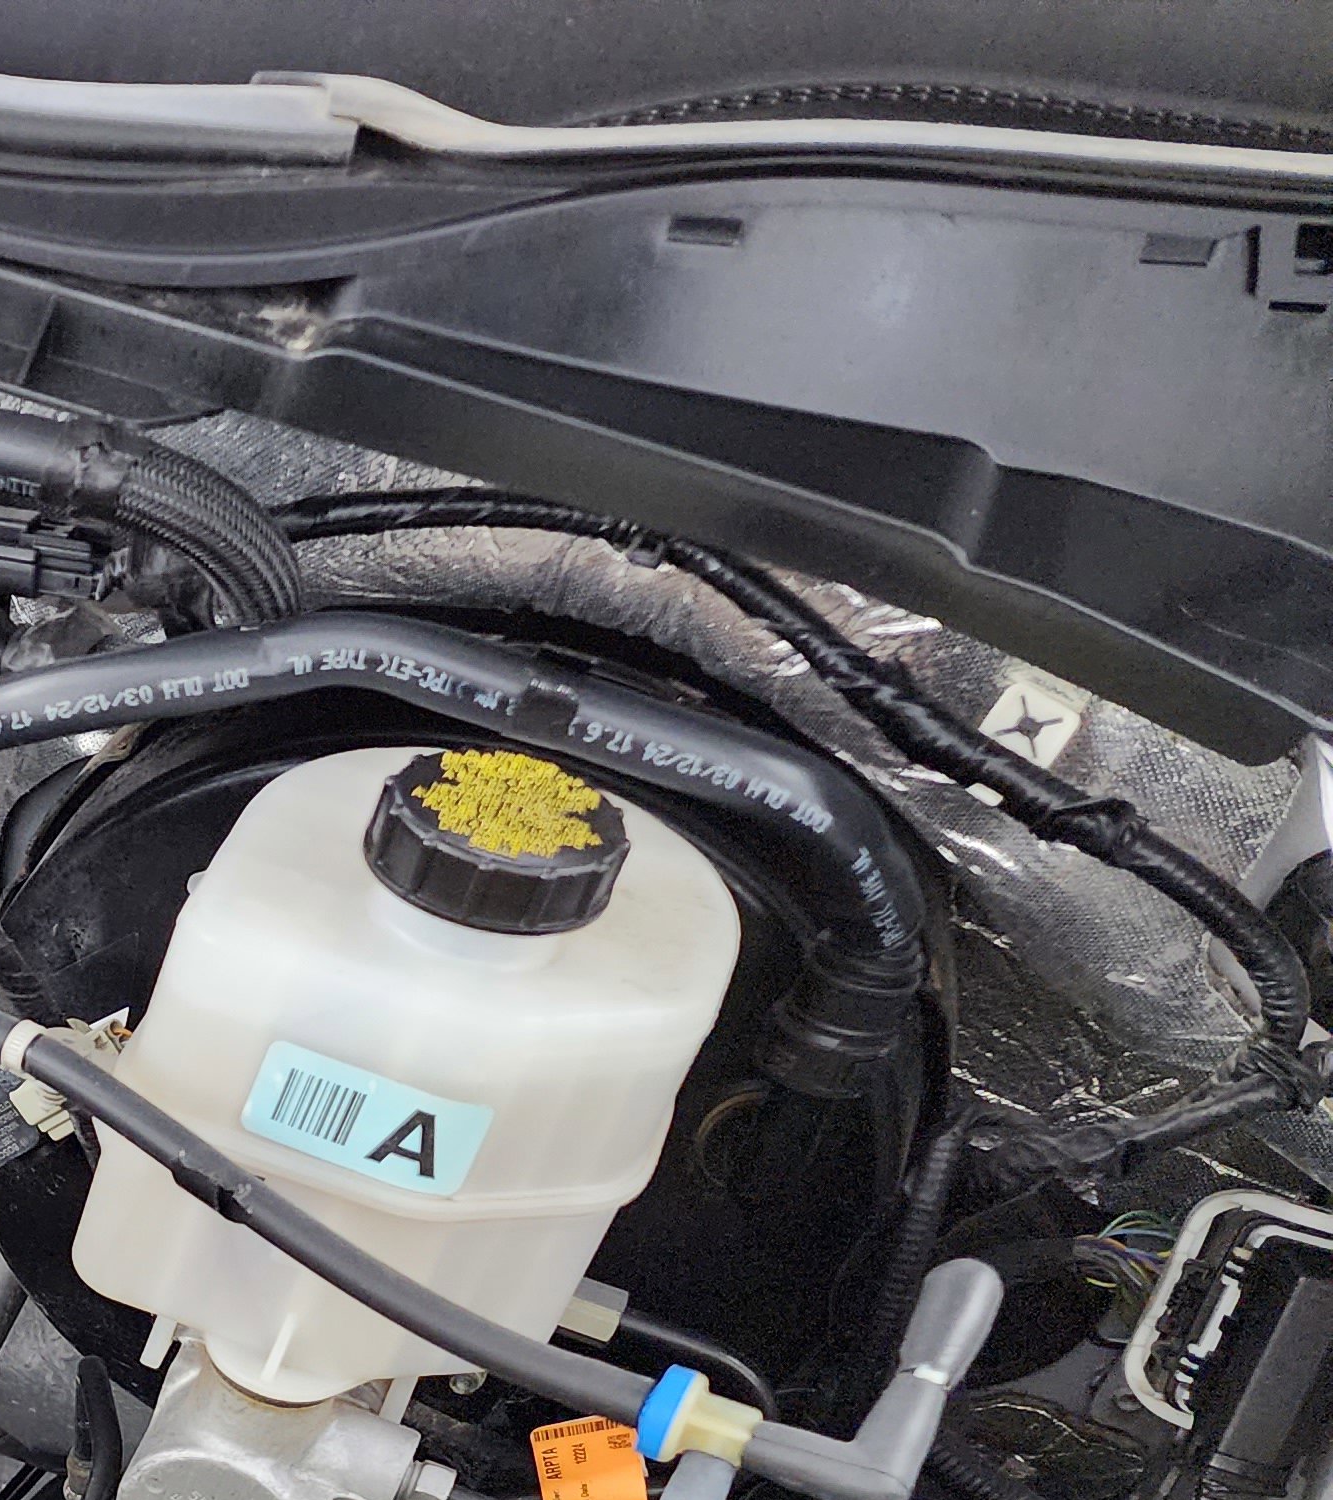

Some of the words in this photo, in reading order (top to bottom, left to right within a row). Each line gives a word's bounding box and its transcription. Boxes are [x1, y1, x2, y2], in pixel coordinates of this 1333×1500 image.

[319, 648, 367, 671] TYPE
[213, 667, 250, 693] DOT
[42, 684, 153, 722] 03/12/24
[364, 1107, 436, 1180] A
[541, 1447, 563, 1480] ARPTA
